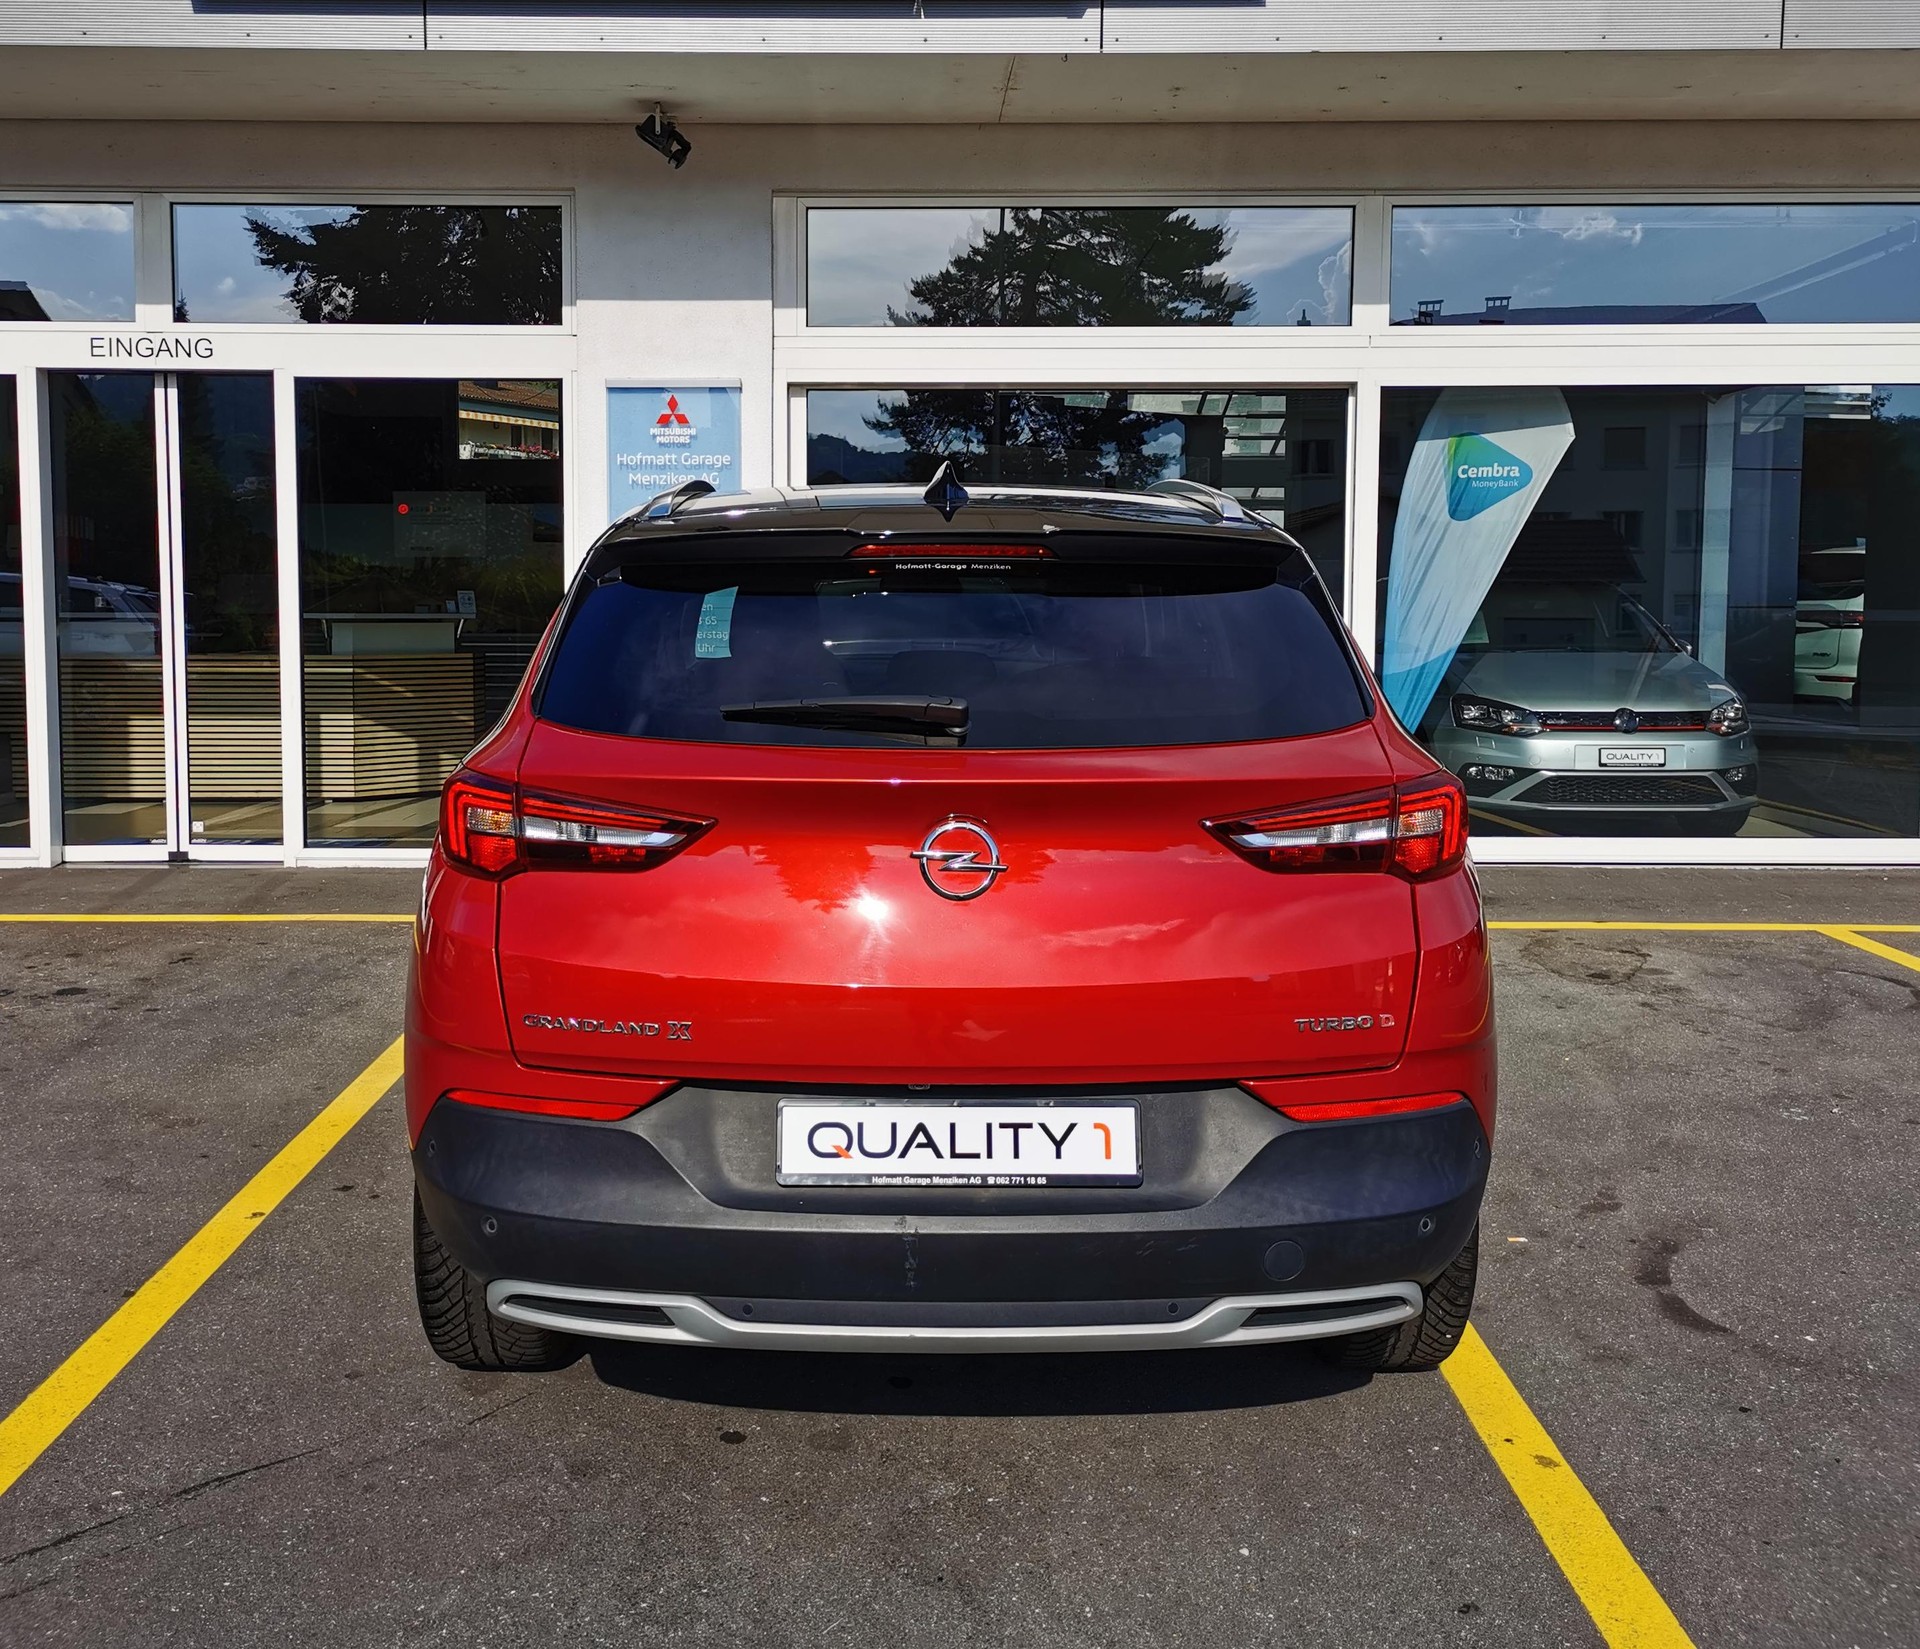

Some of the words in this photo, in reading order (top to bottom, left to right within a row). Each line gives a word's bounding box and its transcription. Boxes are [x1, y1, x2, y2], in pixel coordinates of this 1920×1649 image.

[90, 337, 213, 359] EINGANG
[649, 427, 697, 436] MITSUBISHI
[656, 435, 691, 444] MOTORS
[616, 452, 678, 466] Hofmatt
[681, 452, 732, 468] Garage
[1457, 462, 1521, 479] Cembra
[701, 472, 720, 485] AG
[1472, 479, 1520, 489] MoneyBank
[895, 563, 968, 571] Hofmatt-Garage
[705, 615, 718, 625] 65
[697, 643, 716, 653] Uhr
[523, 1013, 660, 1036] GRANDLAND
[666, 1020, 693, 1041] X
[1294, 1015, 1374, 1033] TURBO
[1379, 1013, 1395, 1028] D
[807, 1121, 1078, 1160] QUALITY
[1093, 1122, 1112, 1160] 1
[872, 1176, 903, 1184] Hofmatt
[903, 1176, 931, 1186] Garage
[932, 1176, 968, 1184] Menziken
[969, 1176, 982, 1184] AG
[996, 1176, 1010, 1185] 062
[1011, 1176, 1025, 1185] 771
[1026, 1176, 1036, 1185] 18
[1037, 1176, 1047, 1185] 65
